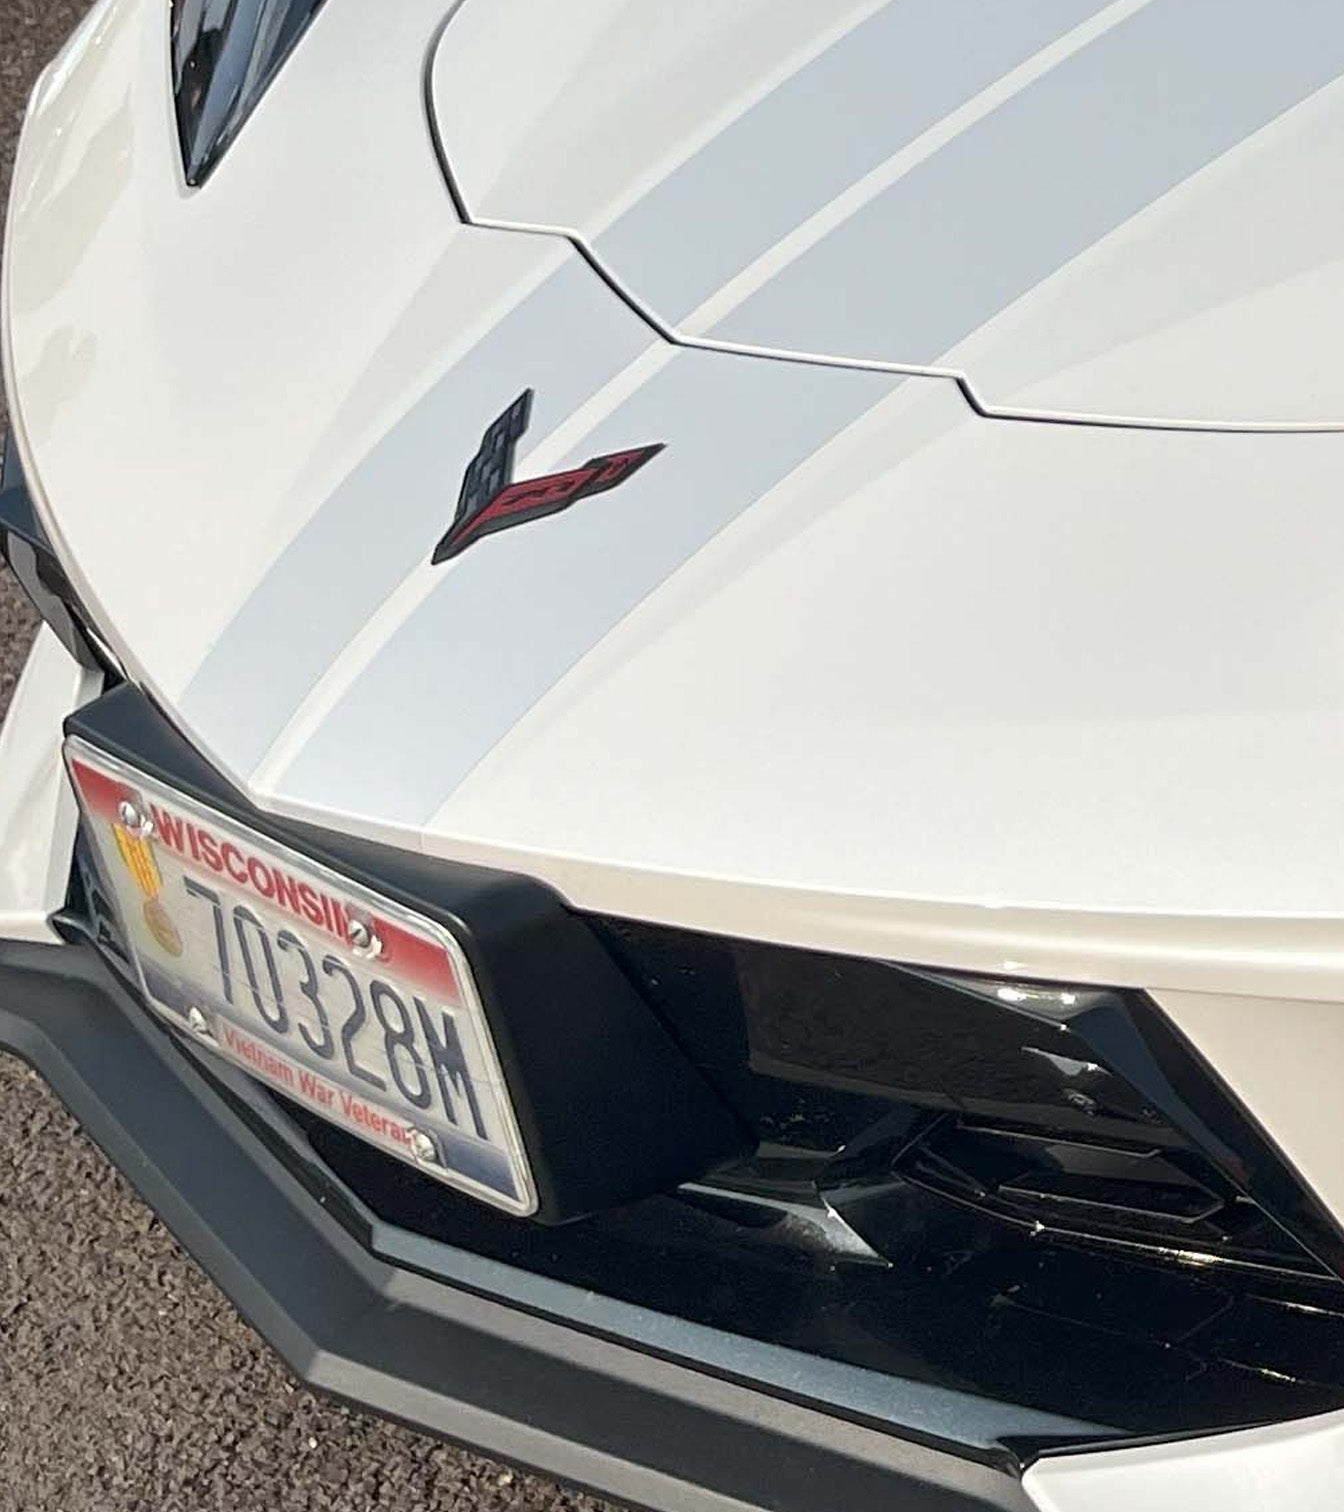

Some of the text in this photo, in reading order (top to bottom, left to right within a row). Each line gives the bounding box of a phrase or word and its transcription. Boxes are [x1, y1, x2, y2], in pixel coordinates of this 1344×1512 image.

[183, 875, 489, 1140] 70328M
[224, 1024, 294, 1086] Vietnam
[299, 1071, 334, 1107] War
